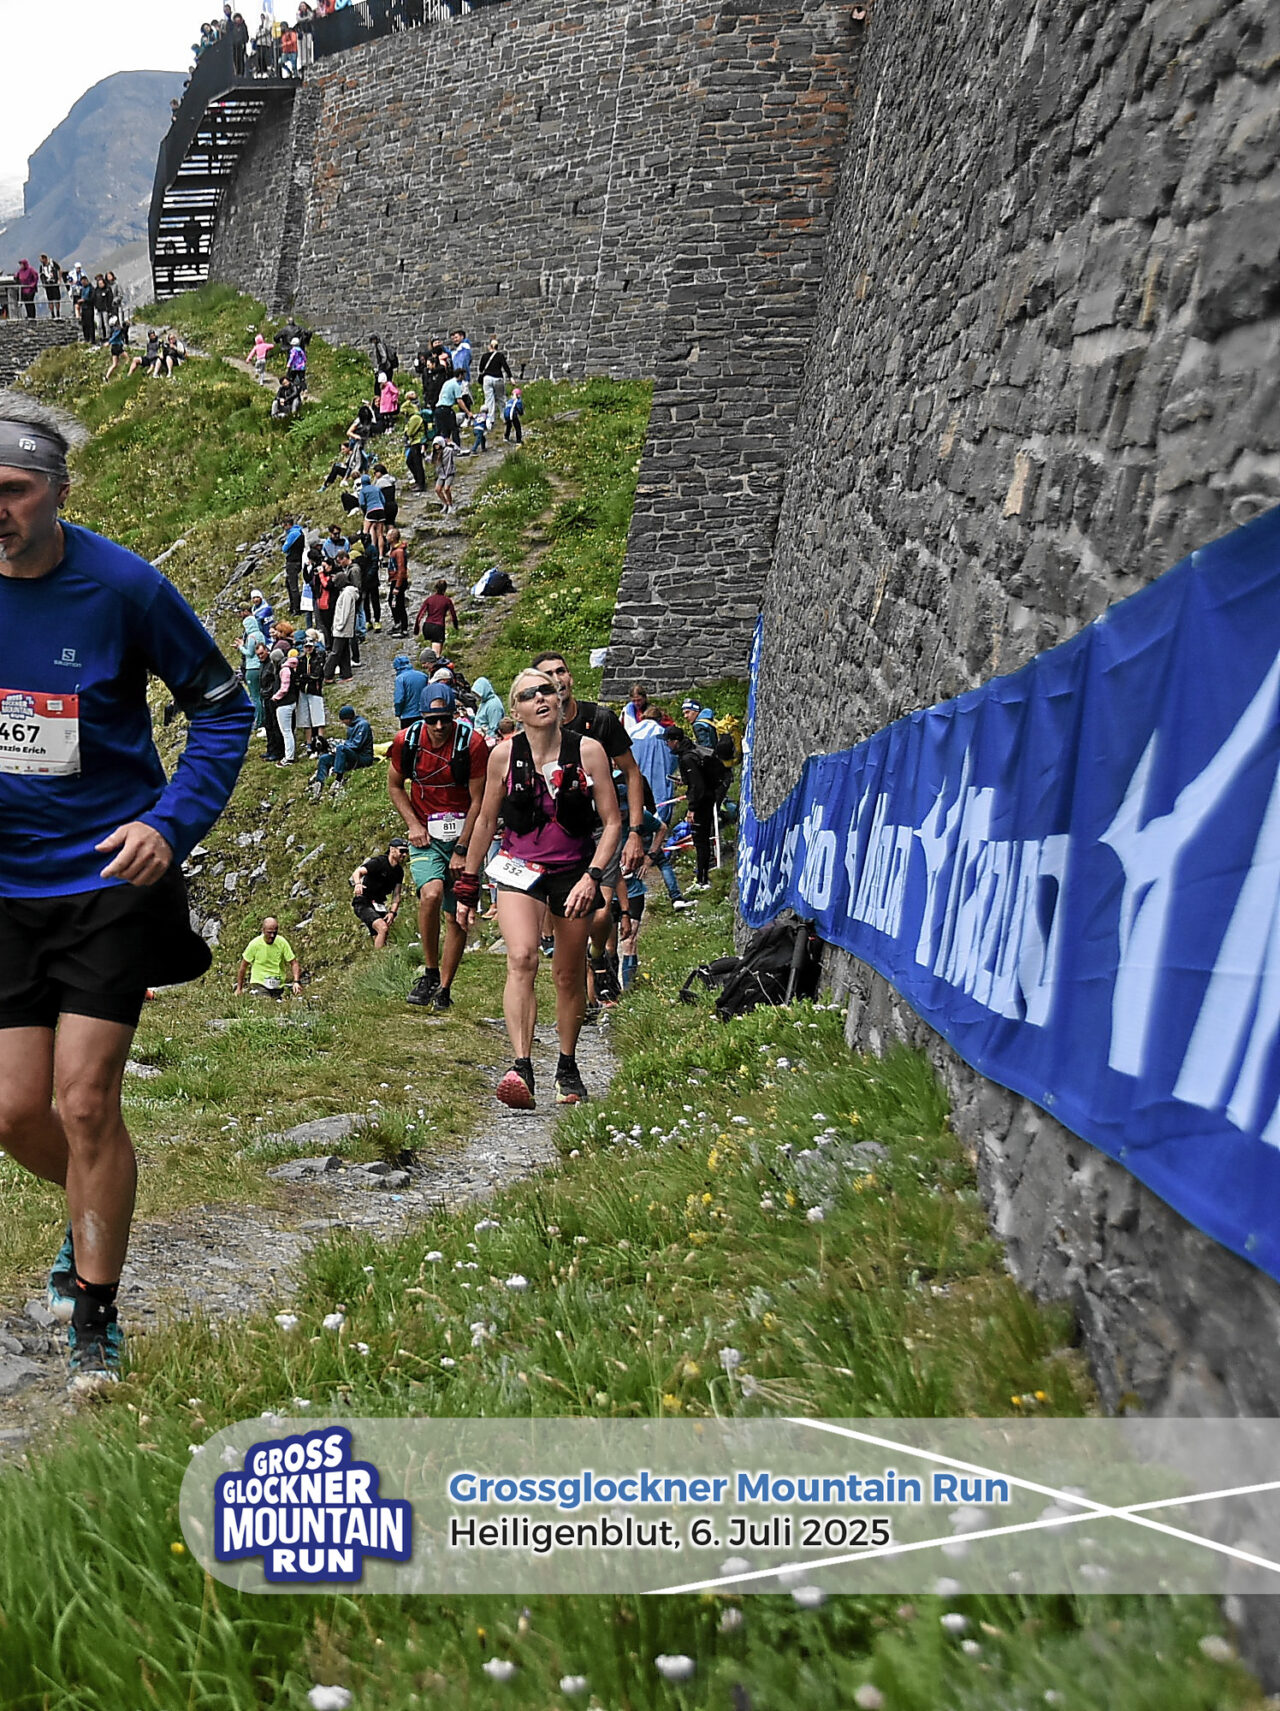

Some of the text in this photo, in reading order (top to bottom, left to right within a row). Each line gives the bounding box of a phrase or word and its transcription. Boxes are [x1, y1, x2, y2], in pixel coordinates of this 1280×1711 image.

[23, 746, 47, 755] Erich
[443, 822, 456, 831] 811
[503, 862, 523, 877] 532
